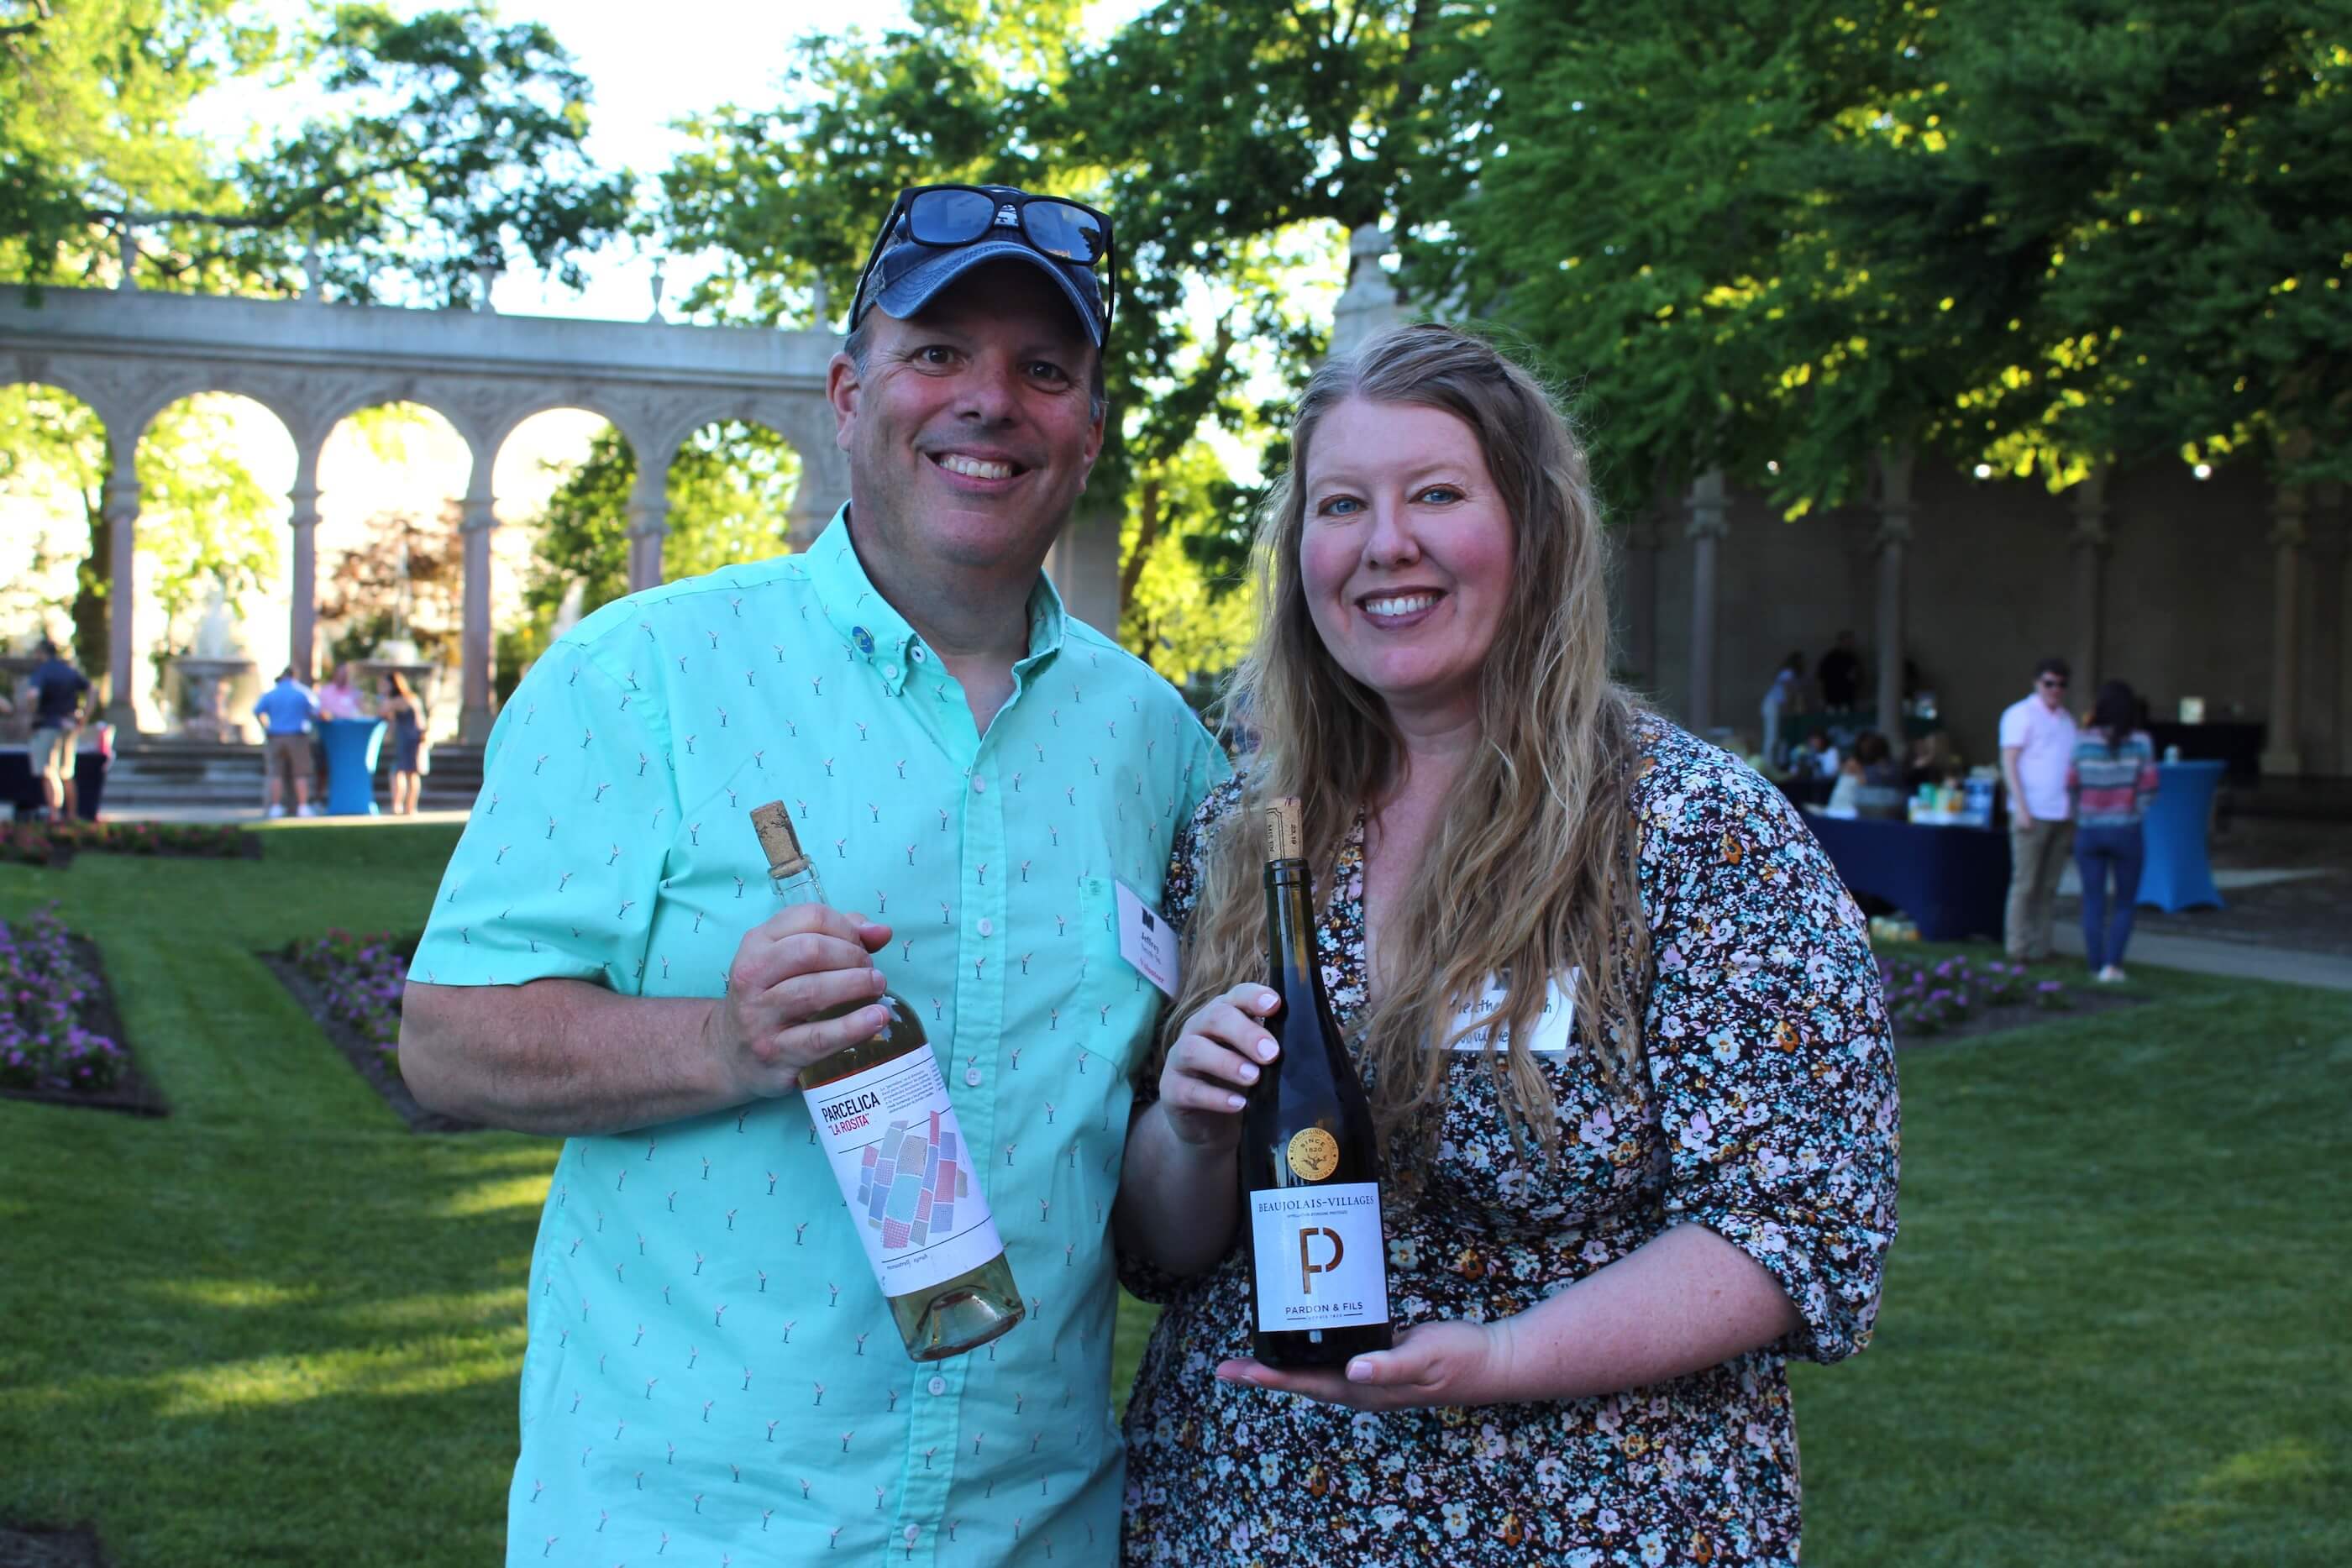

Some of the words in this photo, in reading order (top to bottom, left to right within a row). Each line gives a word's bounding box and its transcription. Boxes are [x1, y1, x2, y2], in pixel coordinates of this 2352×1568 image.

[821, 1091, 881, 1123] PARCELICA
[1299, 1138, 1326, 1148] SINCE
[1258, 1195, 1374, 1213] BEAUJOLAIS-VILLAGES
[1285, 1303, 1330, 1315] PARDON
[1332, 1303, 1339, 1312] &
[1342, 1301, 1363, 1311] FILS
